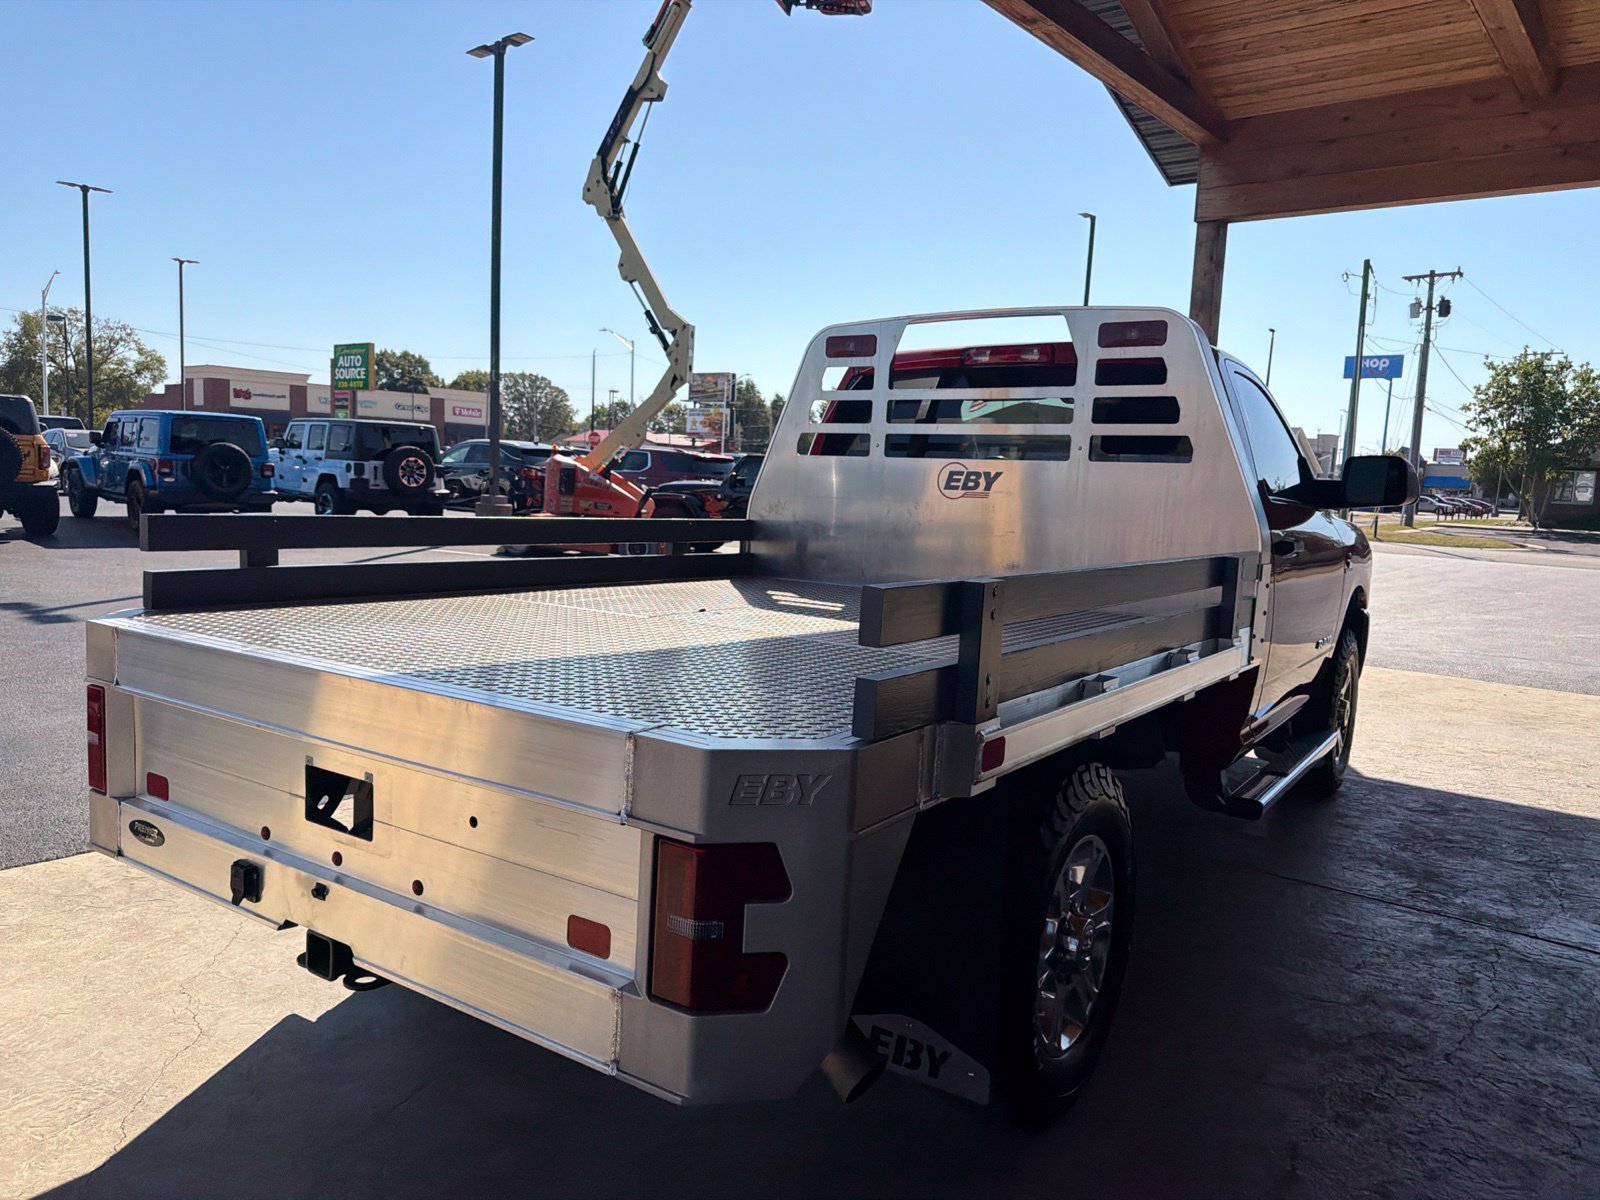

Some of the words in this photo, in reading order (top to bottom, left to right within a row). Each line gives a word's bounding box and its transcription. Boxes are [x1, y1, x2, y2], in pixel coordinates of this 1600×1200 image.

[338, 355, 362, 367] AUTO
[335, 367, 366, 379] SOURCE
[943, 470, 1004, 491] EBY
[728, 774, 832, 806] EBY
[868, 1024, 953, 1079] EBY
